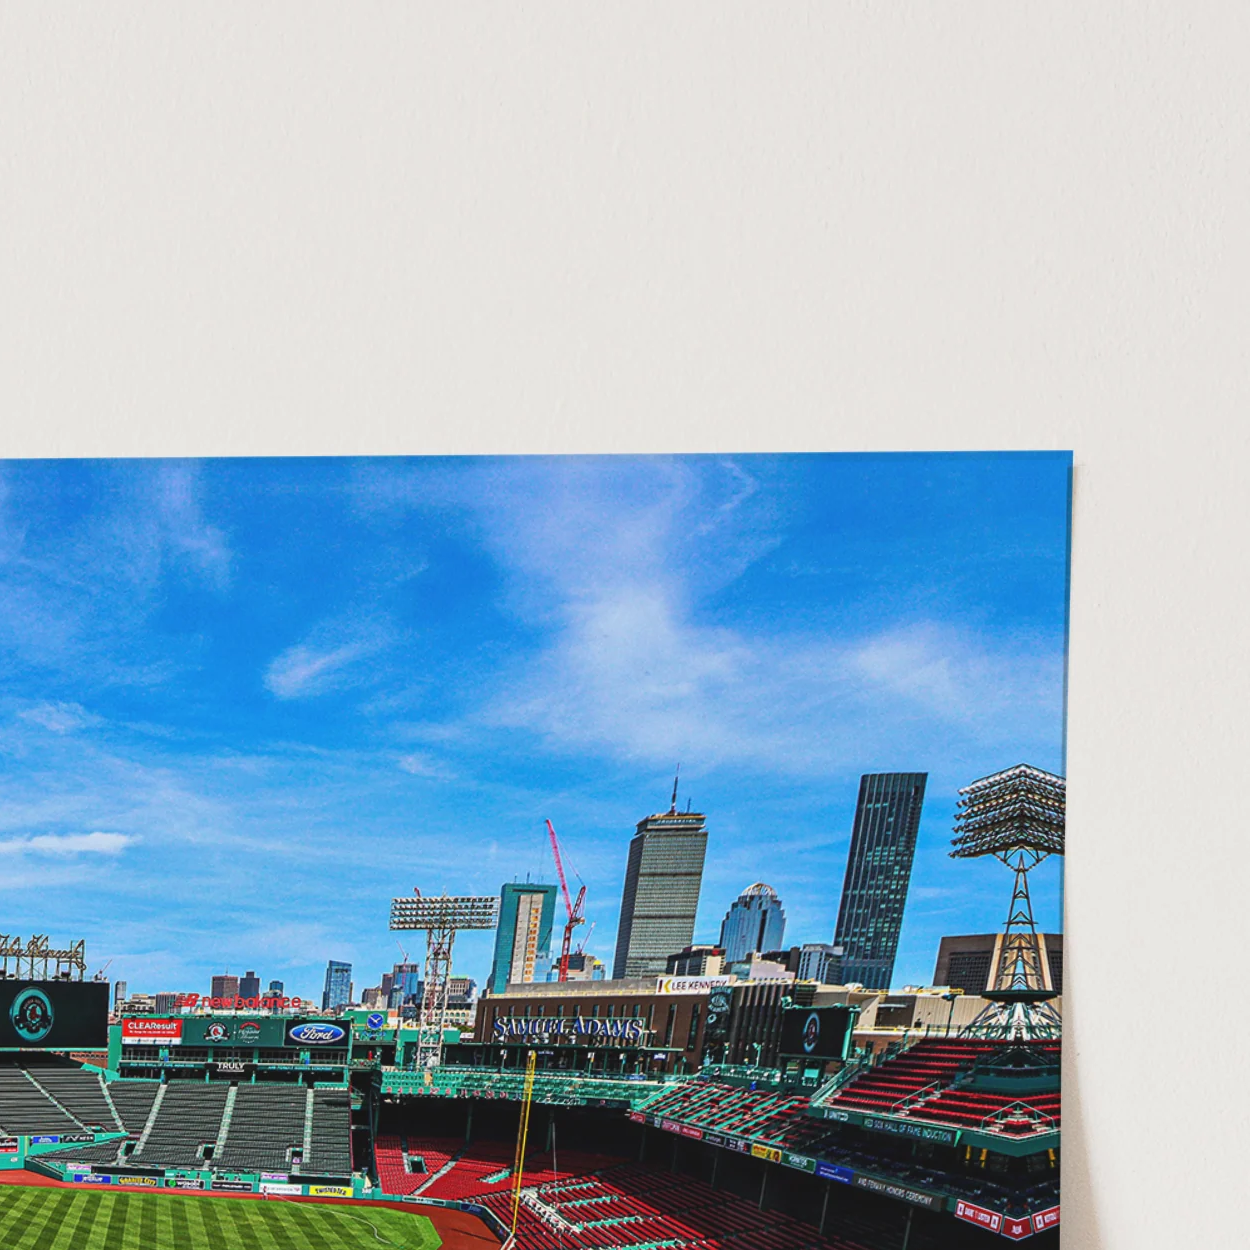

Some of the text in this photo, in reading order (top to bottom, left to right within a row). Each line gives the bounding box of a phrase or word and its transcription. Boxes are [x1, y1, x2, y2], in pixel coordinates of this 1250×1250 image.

[672, 981, 686, 990] LEE
[128, 1022, 177, 1031] CLEAResult
[493, 1015, 643, 1039] SAMUEL ADAMS
[299, 1025, 333, 1041] Ford
[217, 1061, 245, 1071] TRULY
[884, 1121, 898, 1133] HALL
[898, 1123, 907, 1133] OF
[143, 1178, 157, 1186] CITY
[886, 1183, 906, 1198] HONORS
[905, 1187, 933, 1206] CEREMONY
